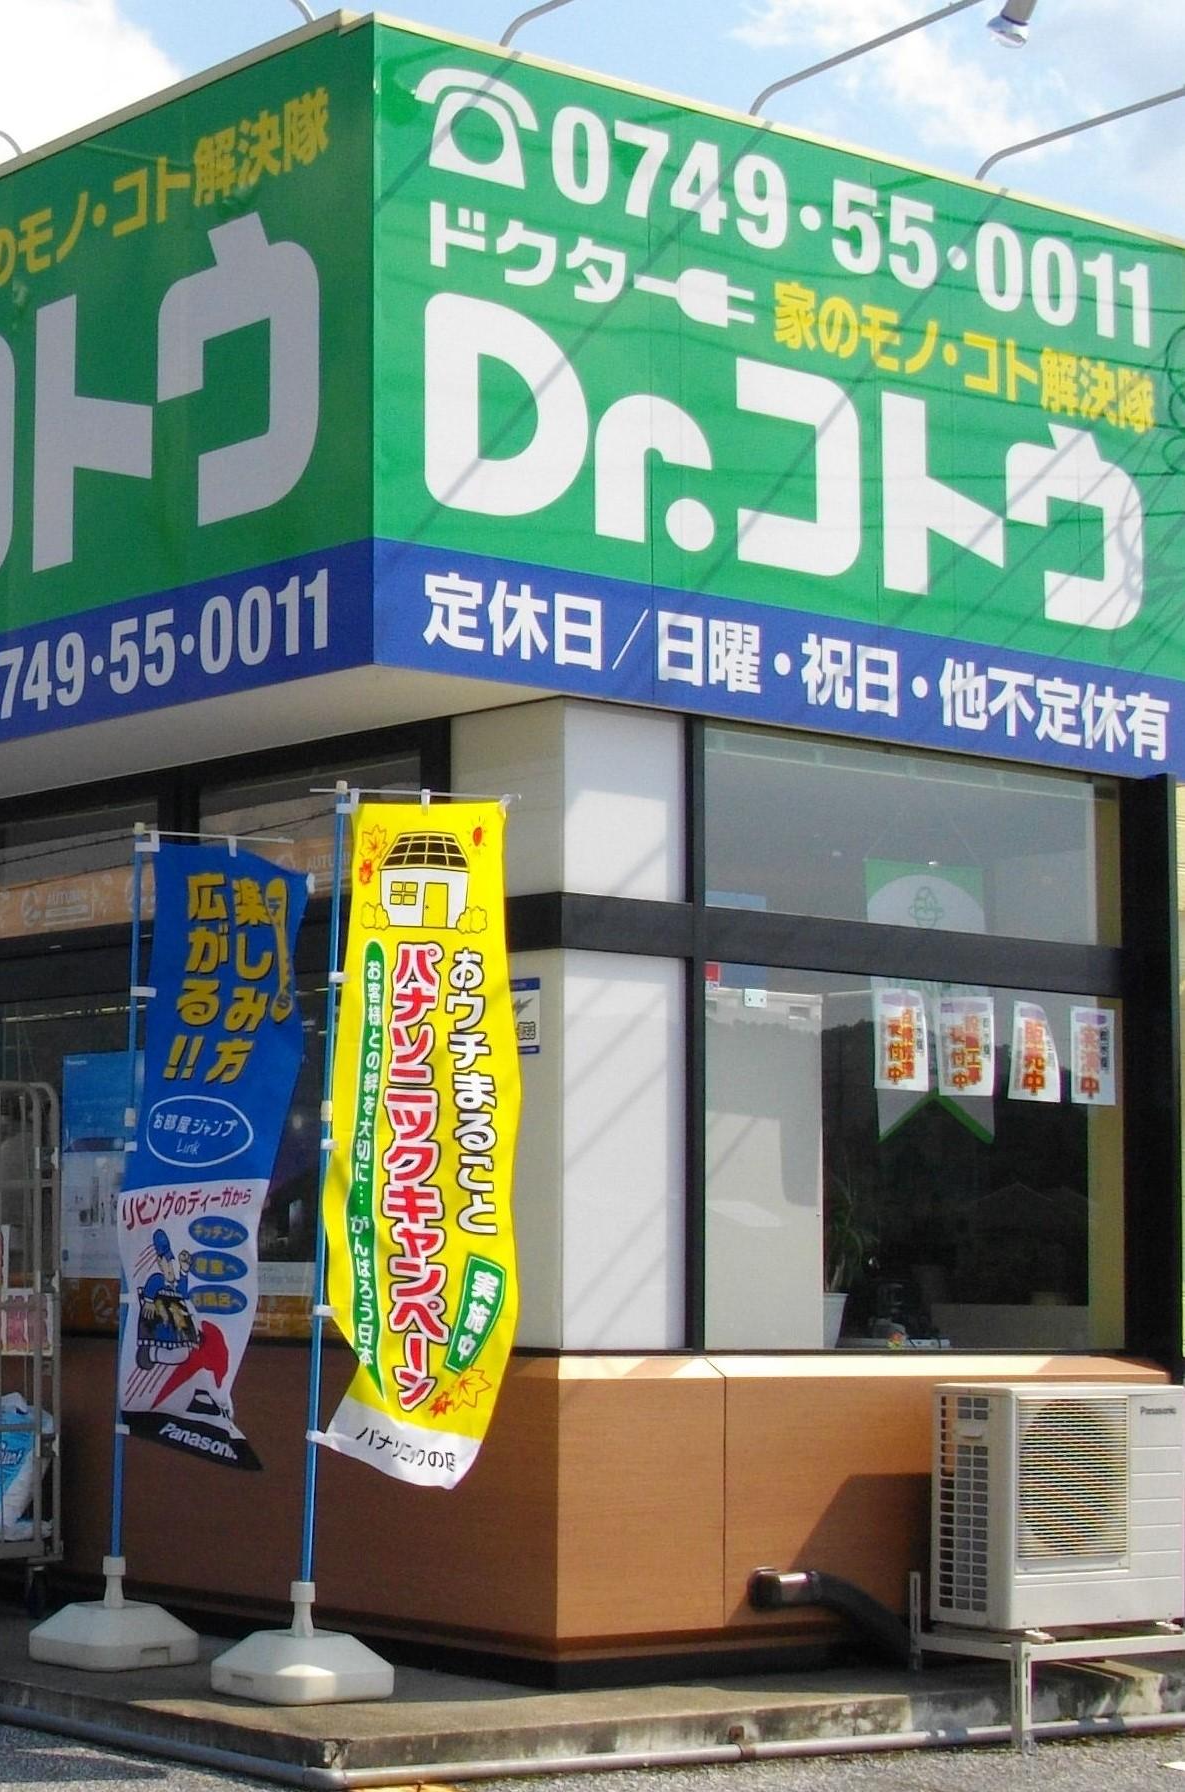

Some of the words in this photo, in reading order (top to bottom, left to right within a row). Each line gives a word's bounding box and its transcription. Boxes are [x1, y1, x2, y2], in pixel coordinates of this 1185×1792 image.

[773, 282, 1156, 435] 家のモノ・コト解決隊
[445, 947, 499, 1235] おウチまるごと
